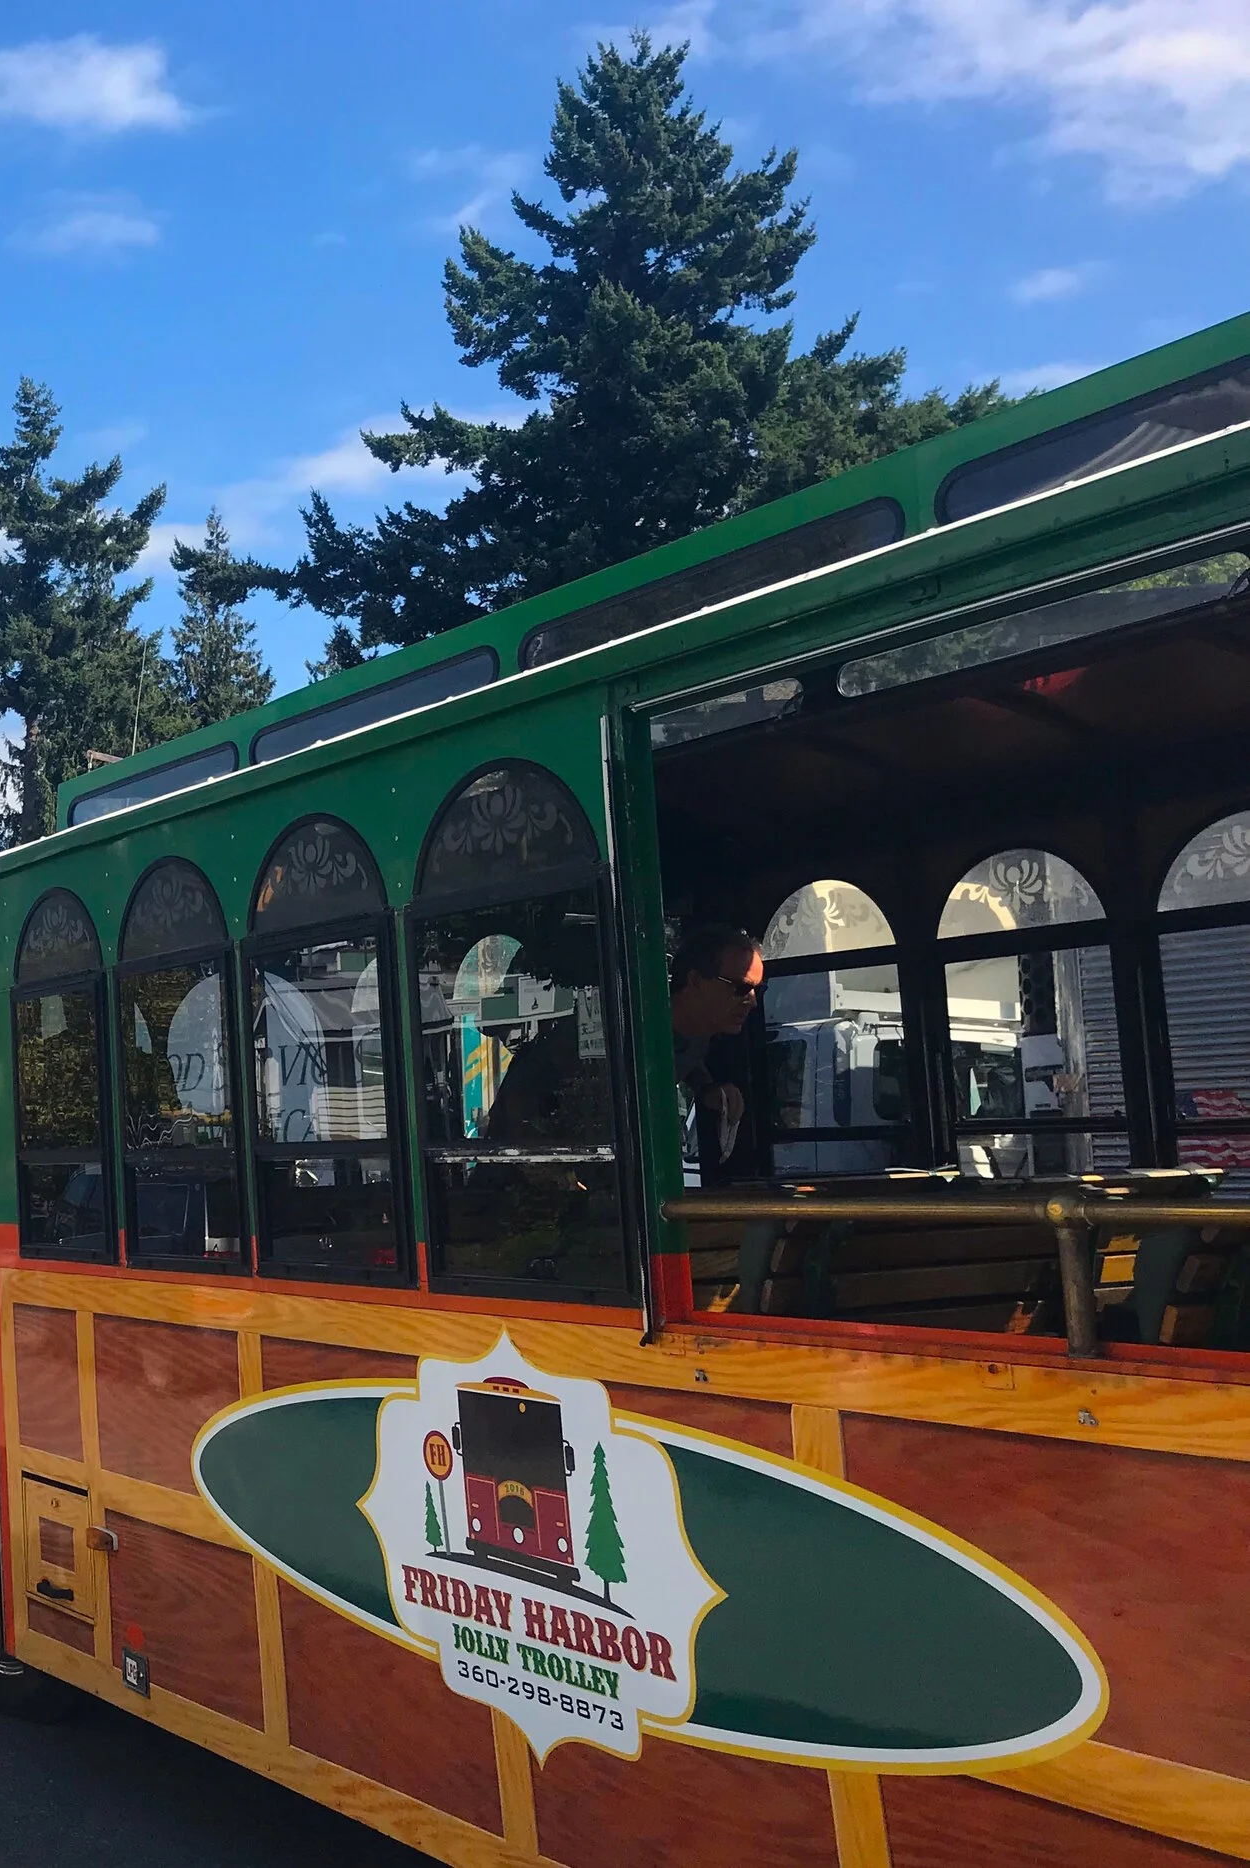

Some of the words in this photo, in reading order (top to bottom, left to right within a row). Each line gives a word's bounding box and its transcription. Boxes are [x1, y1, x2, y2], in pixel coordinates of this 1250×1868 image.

[429, 1443, 446, 1466] FH
[401, 1564, 512, 1632] FRIDAY
[521, 1597, 678, 1683] HARBOR
[452, 1622, 511, 1666] JOLLY
[516, 1642, 620, 1701] TROLLEY
[457, 1659, 624, 1732] 360-298-8873
